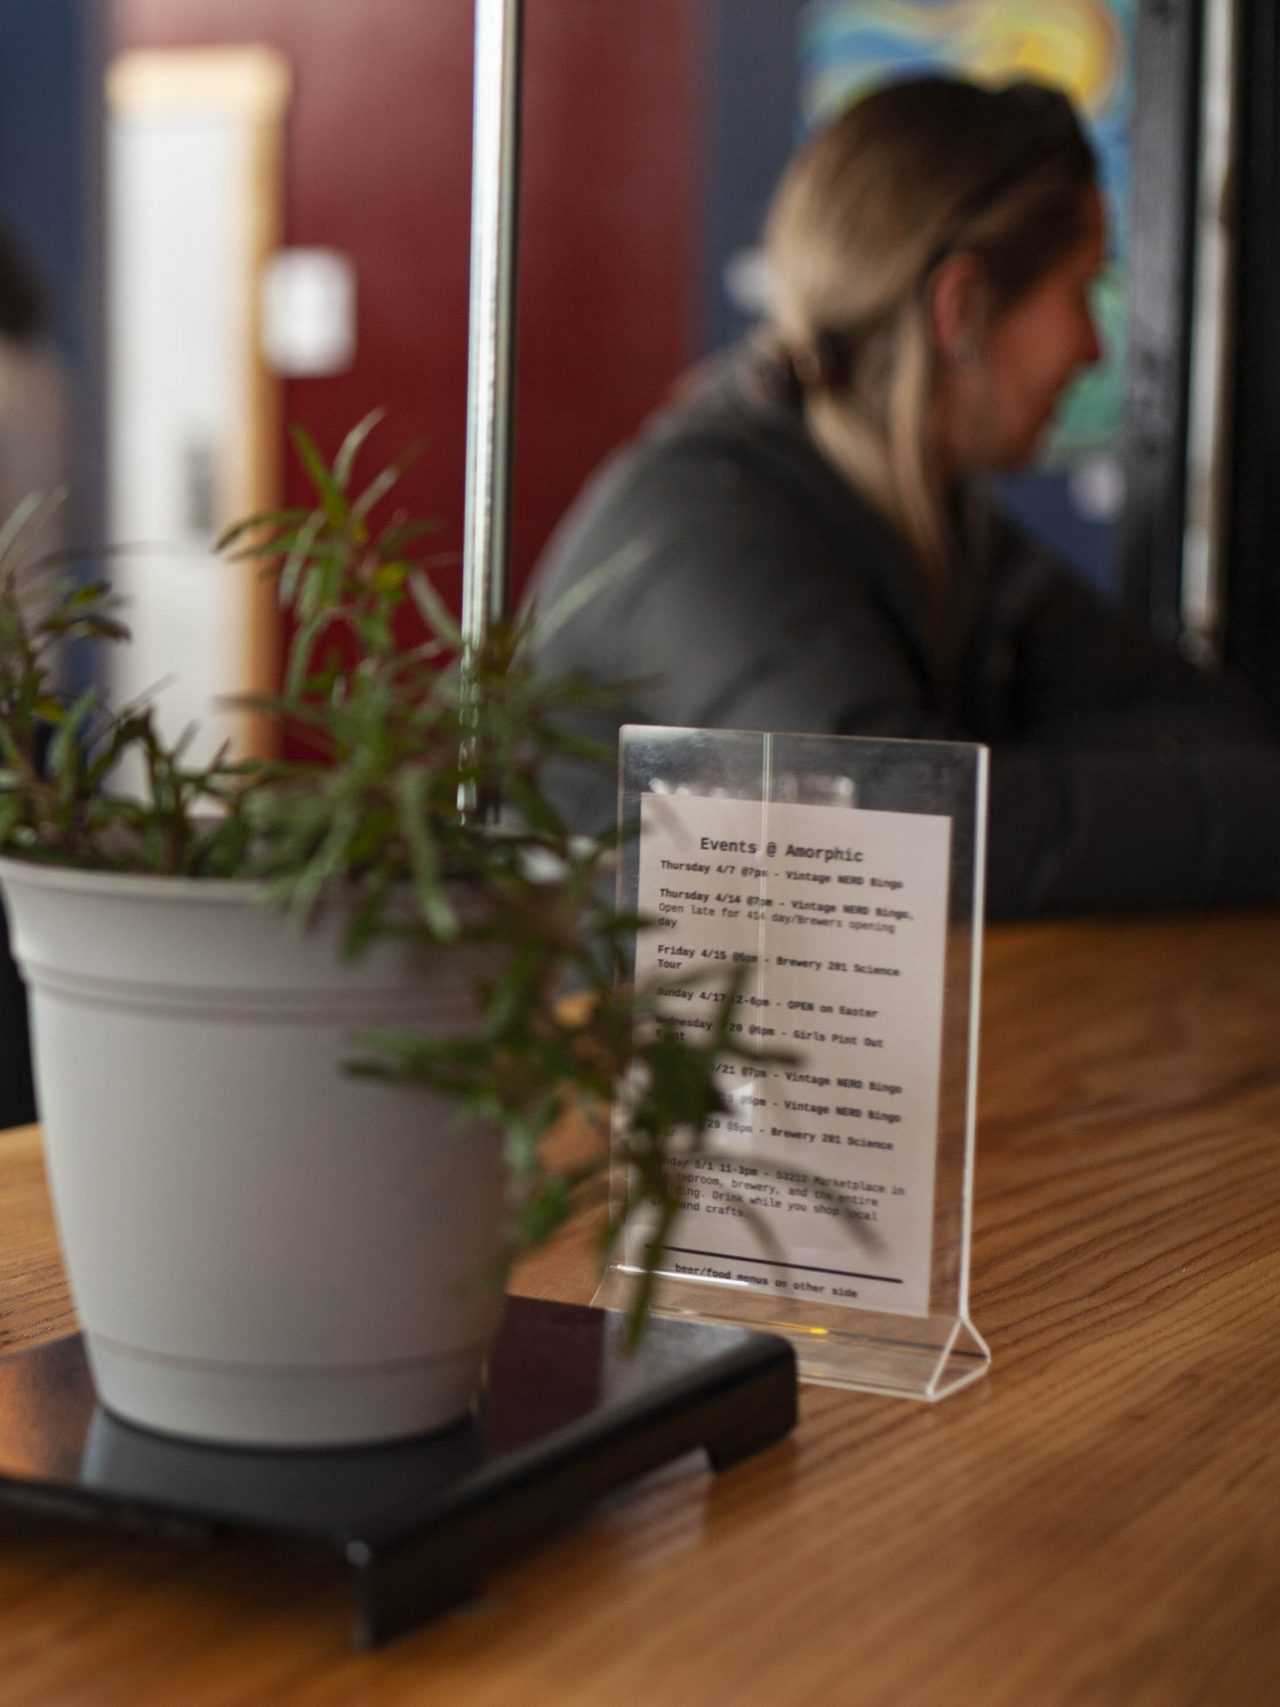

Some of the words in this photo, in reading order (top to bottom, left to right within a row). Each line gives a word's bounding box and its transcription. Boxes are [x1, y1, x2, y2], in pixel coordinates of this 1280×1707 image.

[700, 837, 757, 854] Events
[766, 842, 777, 857] @
[785, 844, 863, 863] Amorphic
[660, 860, 710, 875] Thursday
[716, 865, 736, 875] 4/7
[786, 870, 831, 885] Vintage
[838, 875, 864, 885] NERD
[870, 877, 903, 890] Bingo
[660, 888, 710, 903] Thursday
[715, 893, 741, 904] 4/14
[791, 900, 836, 914] Vintage
[843, 904, 869, 915] NERD
[658, 917, 677, 929] day
[659, 902, 684, 914] Open
[691, 905, 715, 916] late
[722, 907, 741, 918] for
[772, 913, 842, 928] day/Brewers
[849, 921, 896, 935] opening
[657, 945, 695, 959] Friday
[701, 949, 727, 960] 4/15
[776, 956, 822, 972] Brewery
[853, 964, 900, 976] Science
[657, 958, 682, 970] Tour
[656, 987, 694, 1001] Sunday
[700, 992, 727, 1003] 4/17
[788, 1000, 814, 1012] OPEN
[820, 1005, 834, 1013] on
[839, 1005, 878, 1018] Easter
[793, 1030, 826, 1042] Girls
[831, 1033, 858, 1045] Pint
[864, 1037, 884, 1048] Out
[711, 1063, 736, 1075] /21
[785, 1071, 831, 1087] Vintage
[836, 1078, 863, 1089] NERD
[869, 1081, 903, 1095] Bingo
[783, 1100, 830, 1115] Vintage
[835, 1106, 862, 1118] NERD
[868, 1110, 901, 1124] Bingo
[771, 1127, 816, 1142] Brewery
[847, 1136, 894, 1150] Science
[694, 1159, 714, 1171] 5/1
[719, 1163, 758, 1177] 11-3pm
[813, 1176, 885, 1193] Marketplace
[891, 1184, 906, 1196] in
[712, 1190, 743, 1203] Drink
[749, 1197, 782, 1208] while
[787, 1202, 807, 1212] you
[813, 1204, 839, 1217] shop
[731, 1179, 780, 1196] brewery,
[788, 1187, 808, 1197] and
[814, 1190, 833, 1200] the
[838, 1194, 879, 1207] entire
[675, 1263, 732, 1280] beer/food
[737, 1273, 769, 1286] menus
[775, 1279, 787, 1287] on
[793, 1281, 825, 1294] other
[832, 1287, 858, 1298] side
